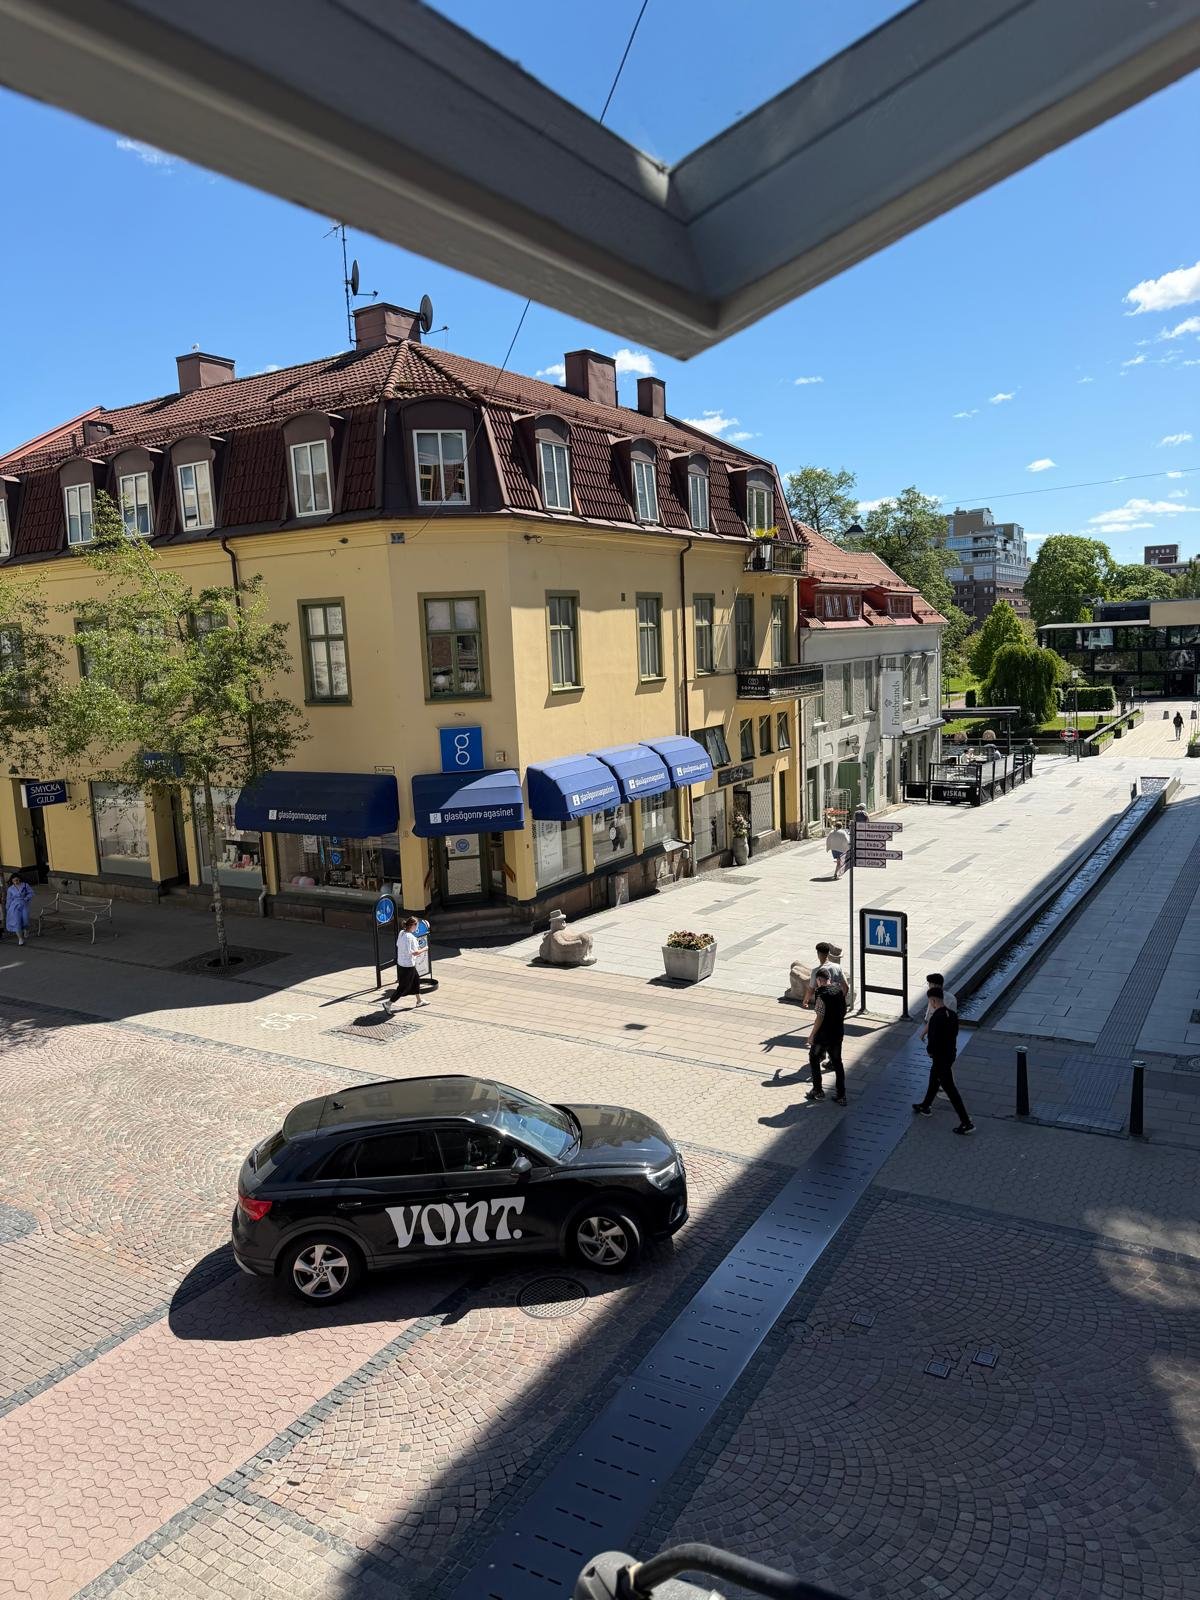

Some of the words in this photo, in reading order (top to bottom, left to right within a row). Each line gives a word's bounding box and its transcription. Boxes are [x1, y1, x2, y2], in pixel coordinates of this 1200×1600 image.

[30, 783, 61, 794] SMYCKA
[942, 790, 967, 798] VISKAN
[36, 795, 55, 804] GULD
